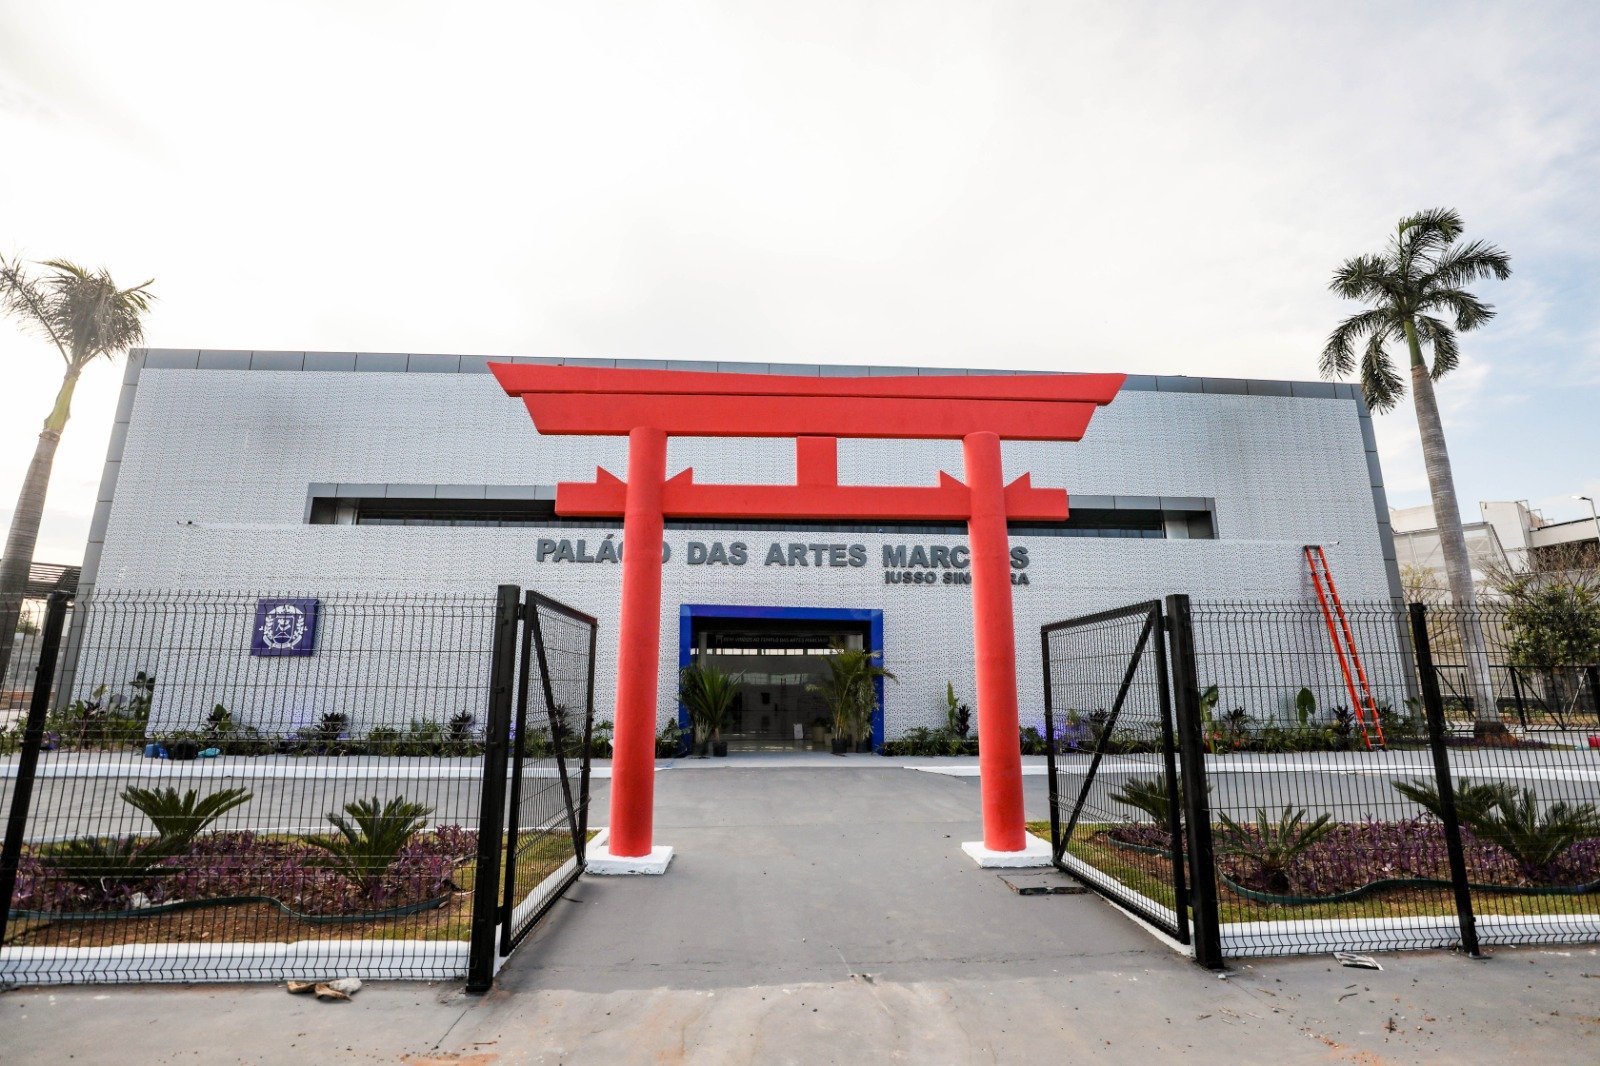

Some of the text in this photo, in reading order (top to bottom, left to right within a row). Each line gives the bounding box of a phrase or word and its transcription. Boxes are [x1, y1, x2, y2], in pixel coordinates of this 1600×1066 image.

[536, 534, 1030, 570] PALÁ DAS ARTES MARCS
[885, 571, 937, 584] IUSSO
